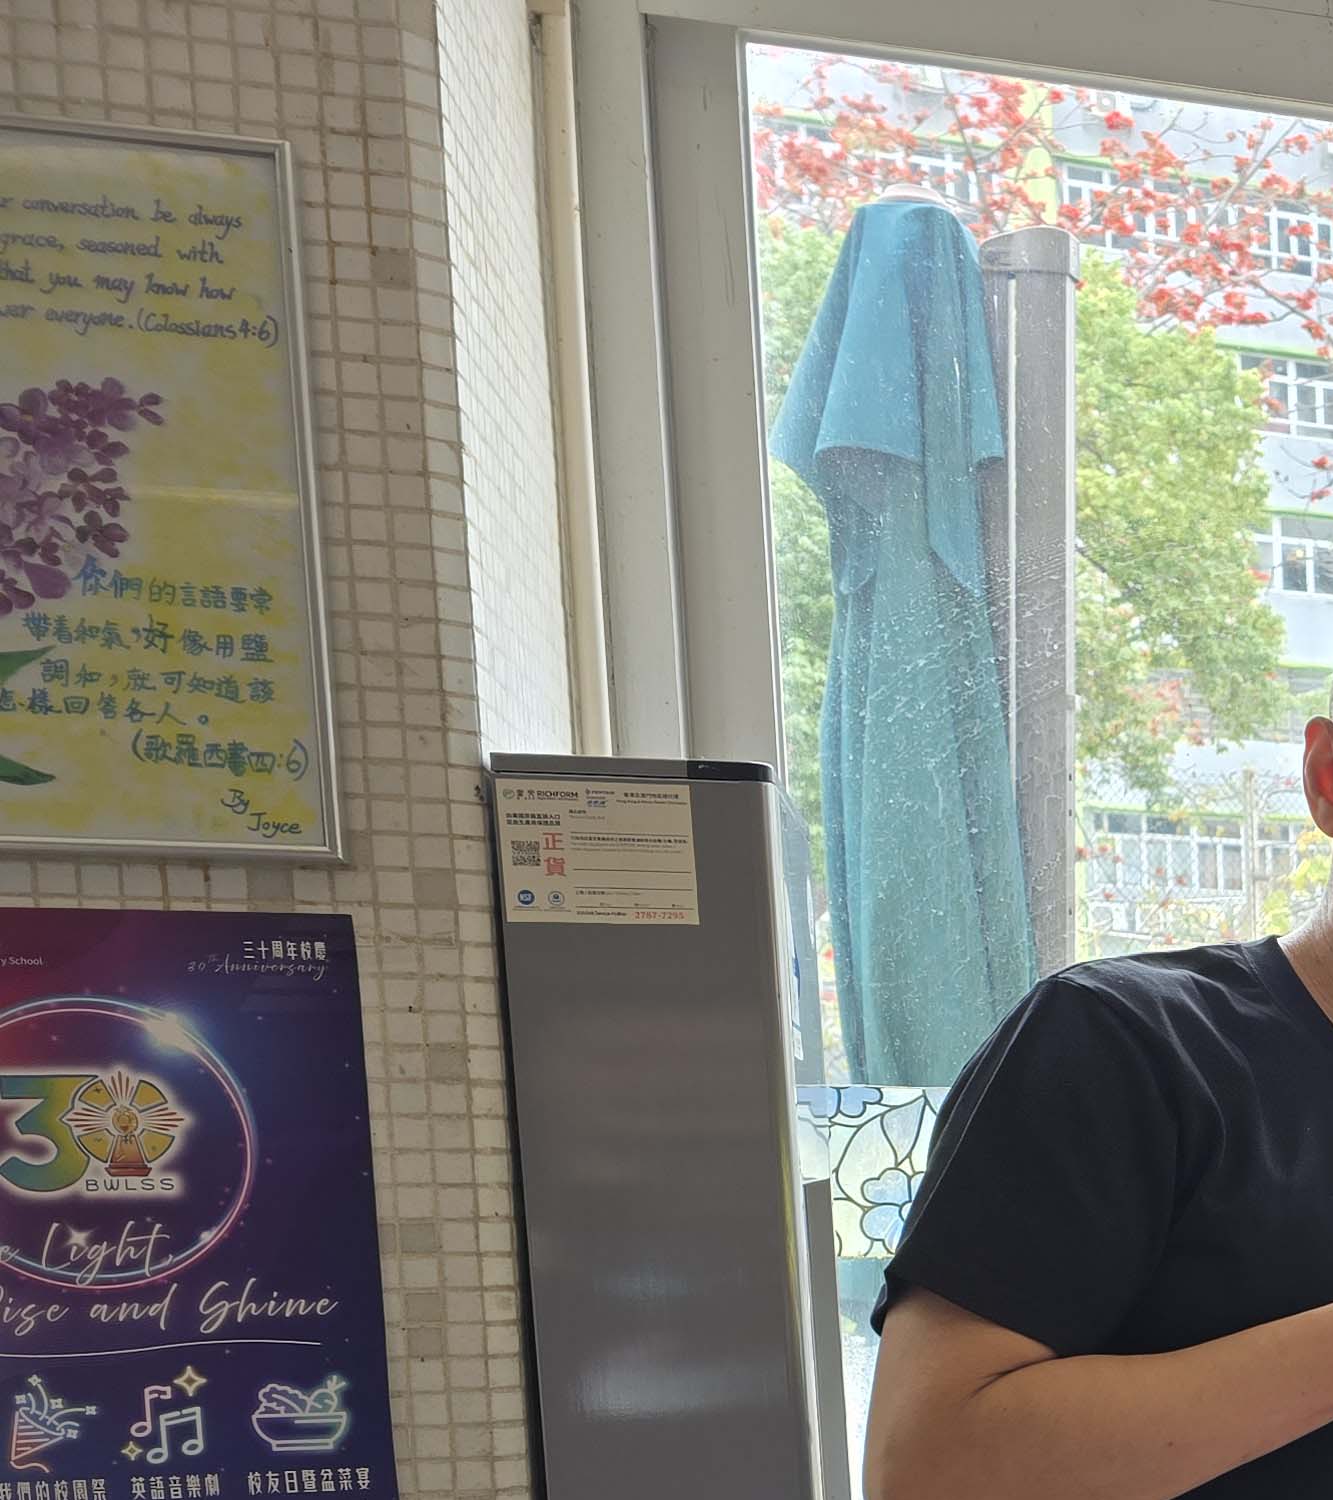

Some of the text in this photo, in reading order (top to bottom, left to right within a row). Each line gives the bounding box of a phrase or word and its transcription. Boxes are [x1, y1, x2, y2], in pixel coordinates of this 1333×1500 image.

[22, 195, 243, 240] conversation be always
[77, 236, 163, 259] seasoned
[176, 246, 224, 264] with
[39, 274, 83, 294] you
[95, 276, 135, 303] may
[145, 273, 189, 298] know
[199, 276, 236, 301] how
[73, 554, 273, 614] 你們的言語要常
[220, 789, 250, 814] By
[247, 812, 302, 838] Joyce
[8, 955, 44, 967] School
[243, 940, 328, 961] 三十周年校慶
[216, 953, 327, 980] Anniversary
[85, 1177, 175, 1192] BWLSS
[0, 1278, 339, 1336] ise and Shine
[130, 1473, 221, 1500] 英語音樂劇
[247, 1467, 371, 1494] 校友日暨盆菜宴
